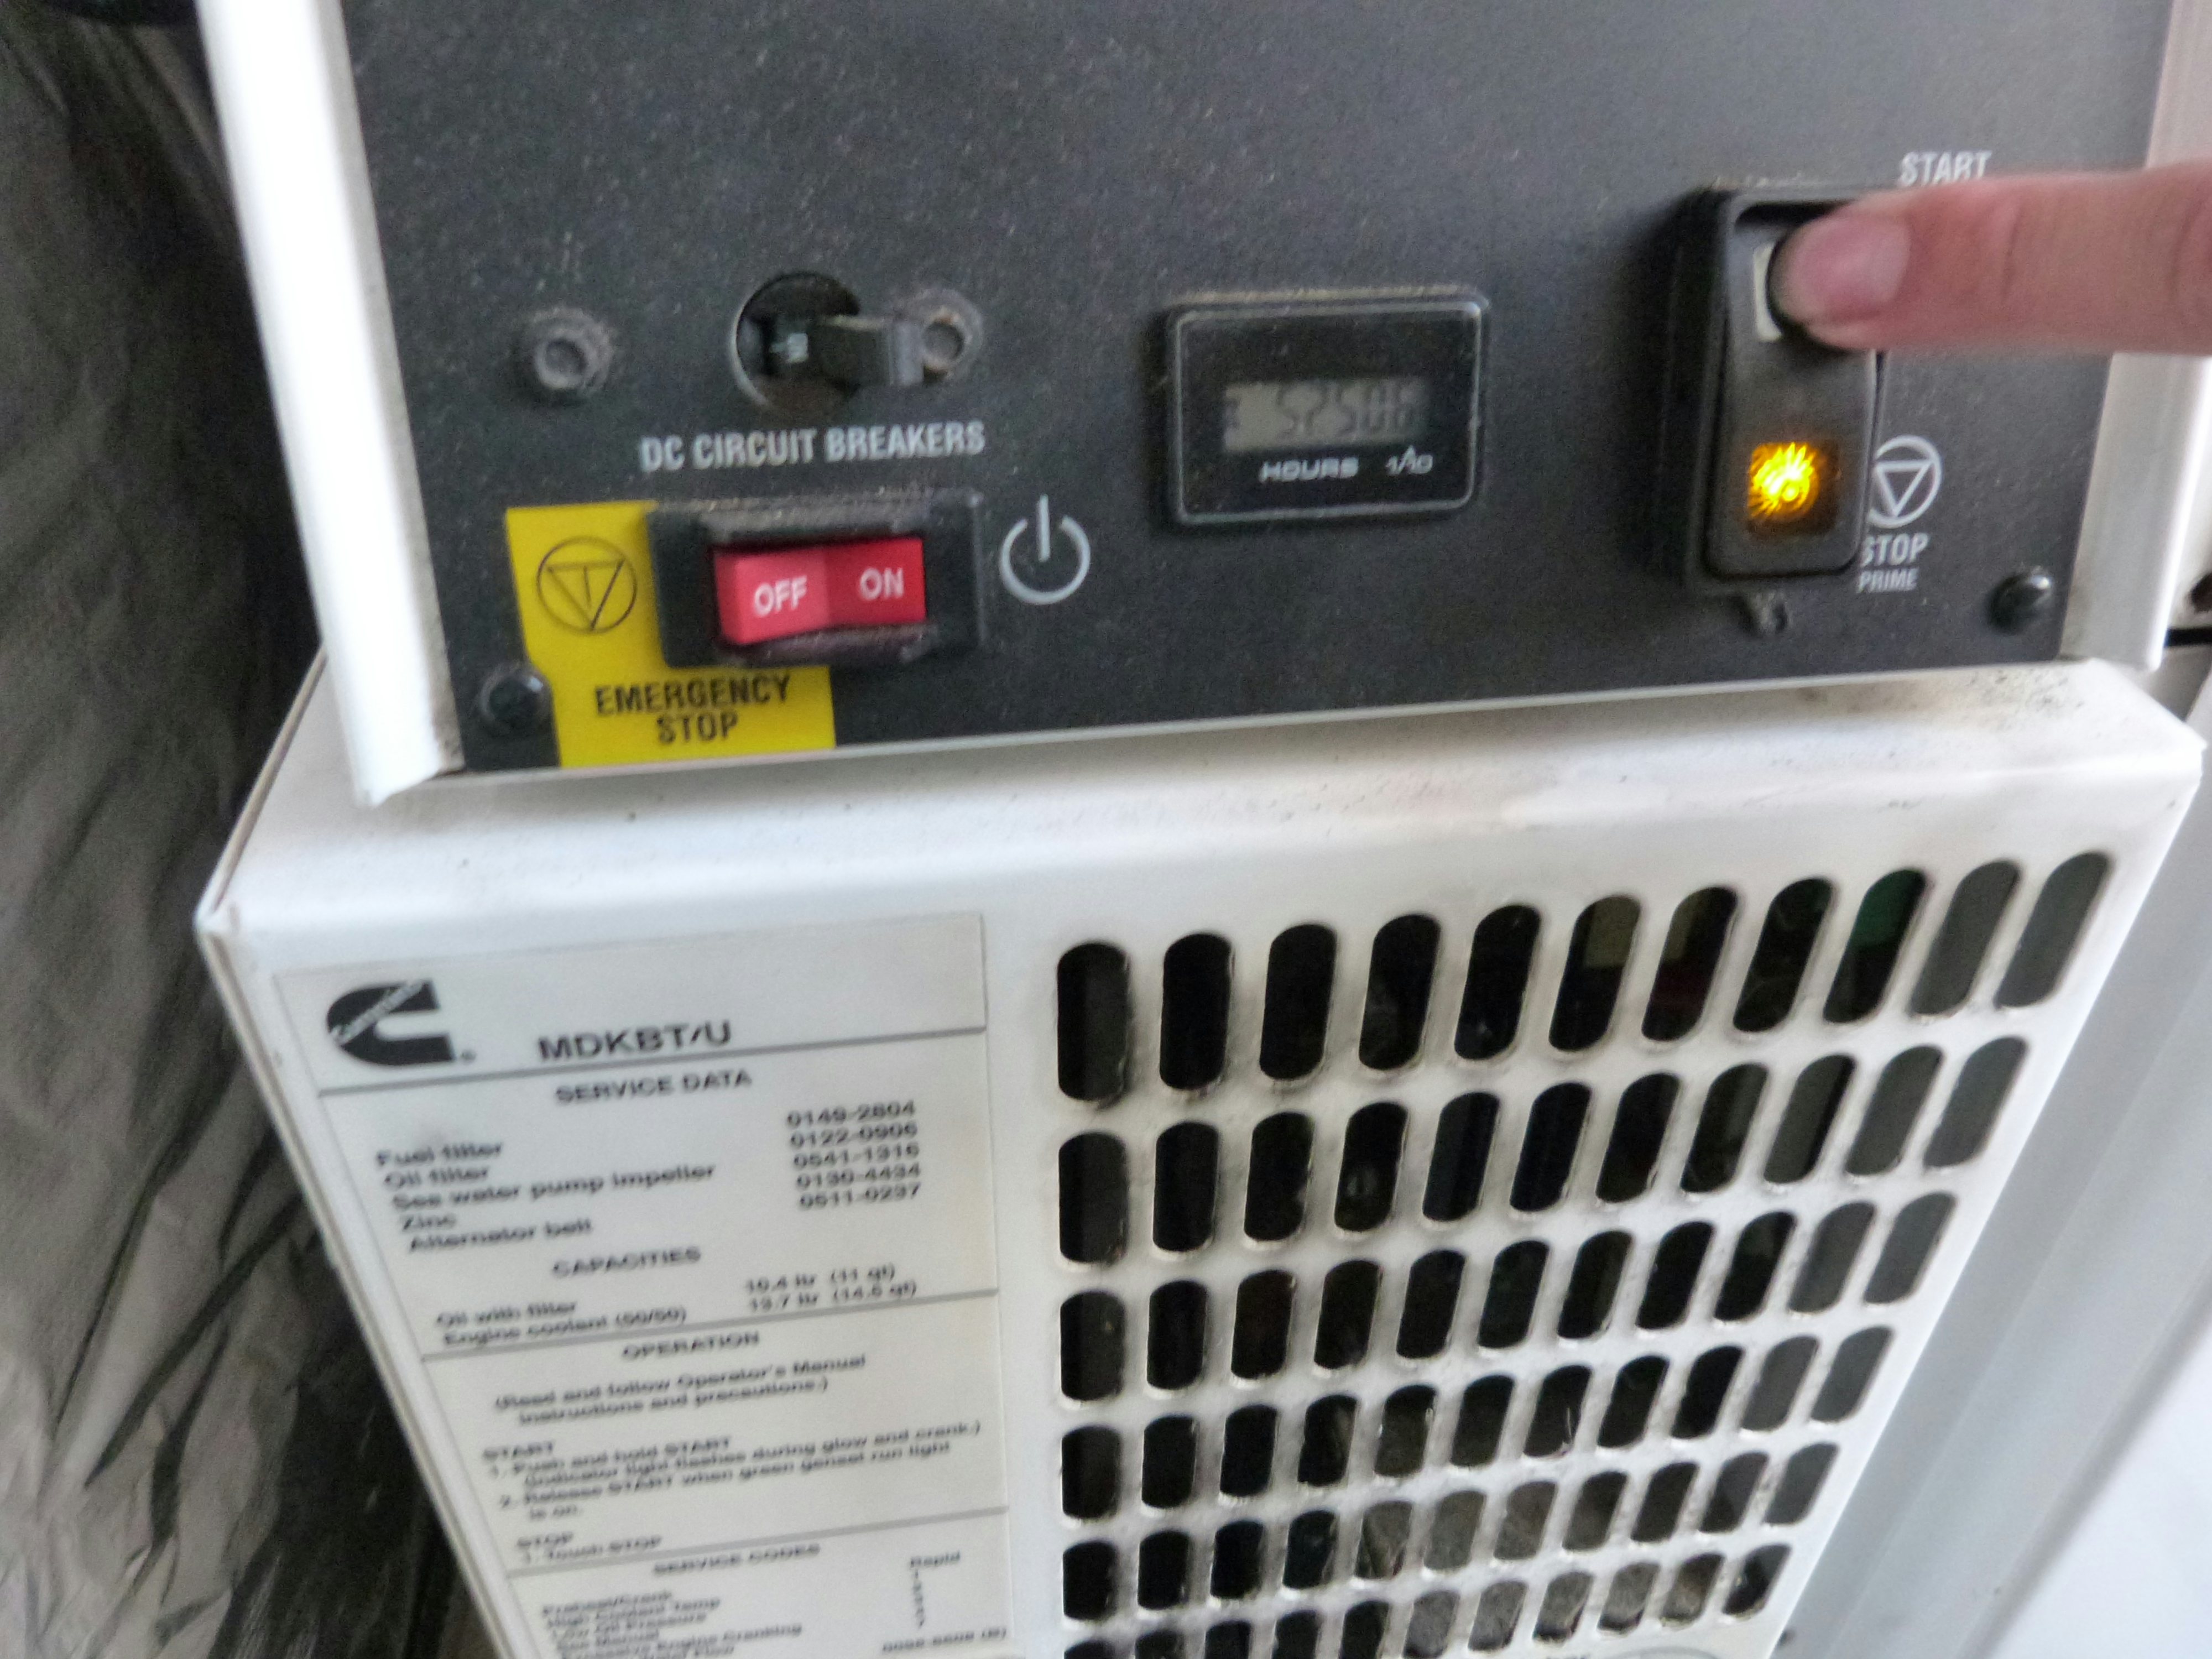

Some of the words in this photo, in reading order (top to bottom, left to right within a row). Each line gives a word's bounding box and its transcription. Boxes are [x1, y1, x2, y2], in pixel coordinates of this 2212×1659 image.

[1898, 150, 1992, 187] START
[639, 435, 685, 473] DC
[693, 429, 817, 469] CIRCUIT
[825, 420, 986, 463] BREAKERS
[1259, 457, 1359, 483] HOURS
[1385, 445, 1433, 476] 1/10
[1860, 533, 1930, 567] STOP
[753, 575, 807, 618] OFF
[859, 567, 904, 601] ON
[1856, 567, 1919, 593] PRIME
[595, 674, 791, 716] EMERGENCY
[656, 711, 738, 745] STOP
[538, 1020, 731, 1060] MDKBT/U
[555, 1075, 674, 1103] SERVICE
[682, 1068, 753, 1091] DATA
[376, 1147, 435, 1166] Fuel
[441, 1142, 503, 1160] filter
[384, 1170, 420, 1188] Oil
[429, 1165, 489, 1184] filter
[450, 1185, 521, 1204] water
[531, 1178, 604, 1202] pump
[612, 1165, 716, 1189] impeller
[410, 1227, 538, 1252] Alternator
[544, 1218, 592, 1237] belt
[552, 1245, 701, 1278] CAPACITIES
[622, 1331, 759, 1360] OPERATION
